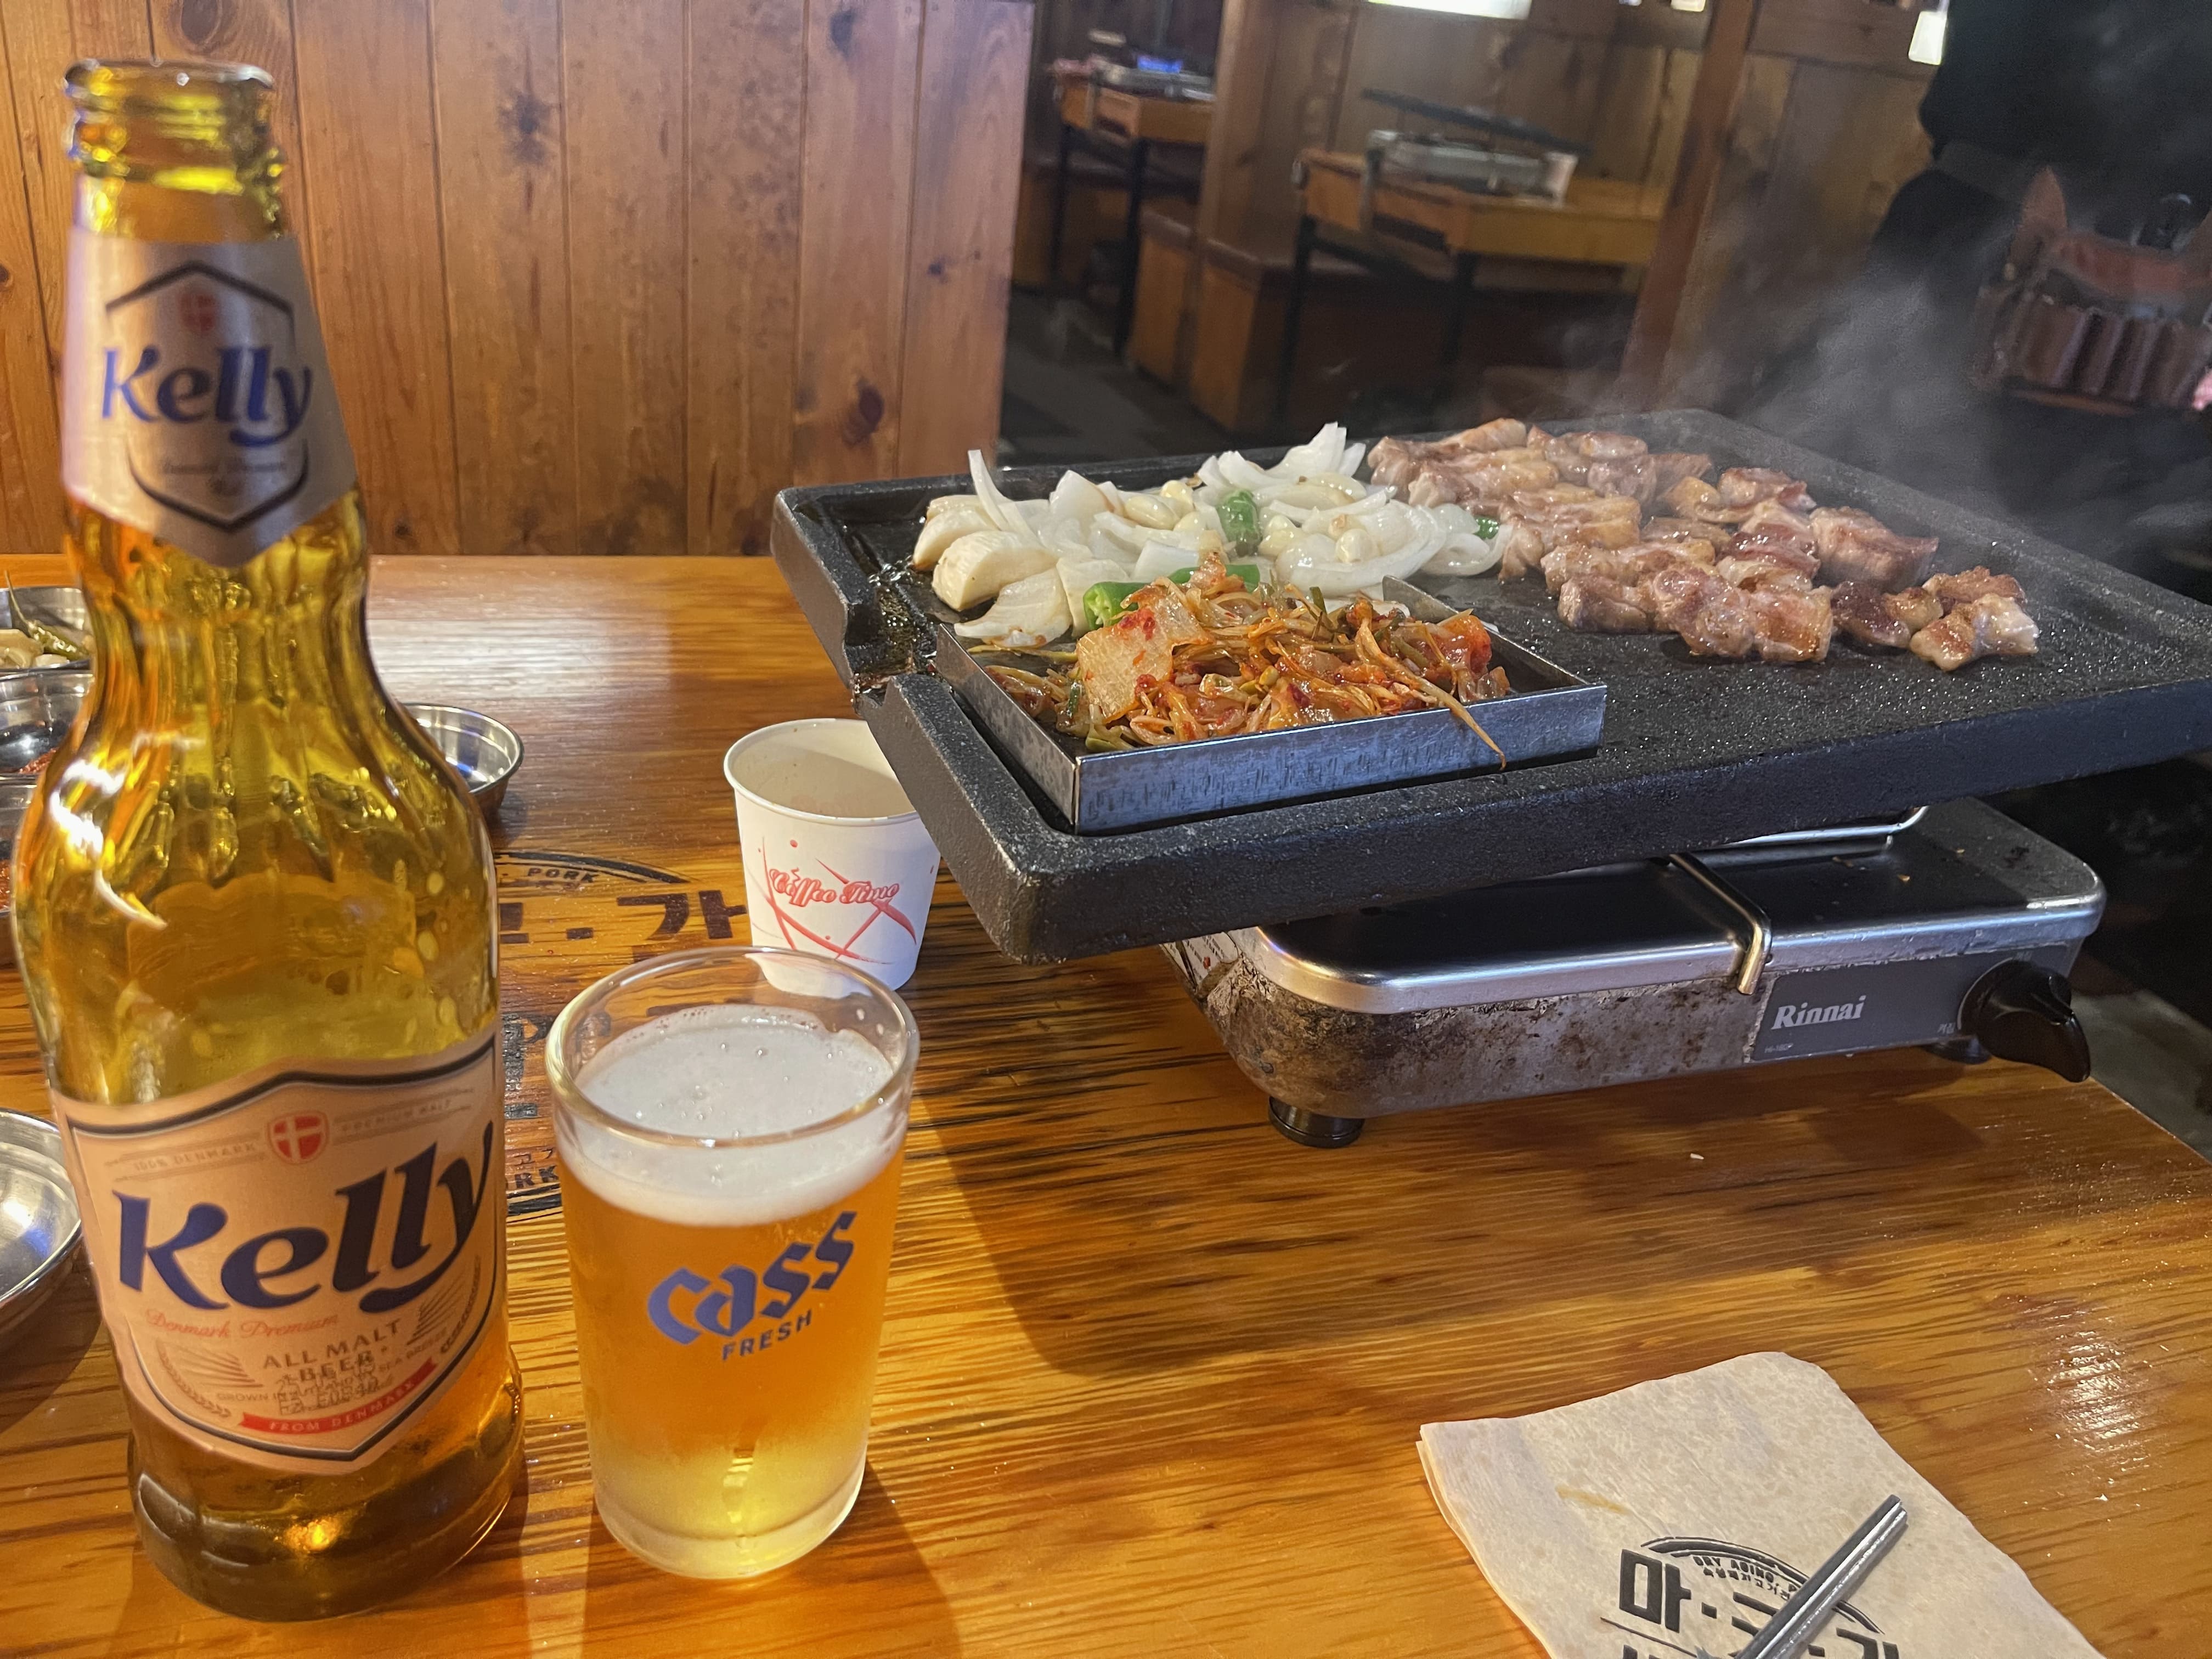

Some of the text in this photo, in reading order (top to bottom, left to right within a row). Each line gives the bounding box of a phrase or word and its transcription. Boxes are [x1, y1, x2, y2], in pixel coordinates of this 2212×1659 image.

[101, 345, 313, 448] Kelly
[528, 867, 600, 883] PORK
[769, 868, 900, 907] Coffee Time
[1771, 995, 1866, 1030] Rinnai
[173, 1142, 257, 1164] DENMARK
[111, 1119, 494, 1313] Kelly
[144, 1309, 230, 1338] Denmark
[721, 1309, 812, 1361] FRESH
[263, 1318, 400, 1369] ALL MALT
[300, 1349, 374, 1381] BEER
[270, 1421, 320, 1431] FROM
[331, 1381, 415, 1426] DENMARK
